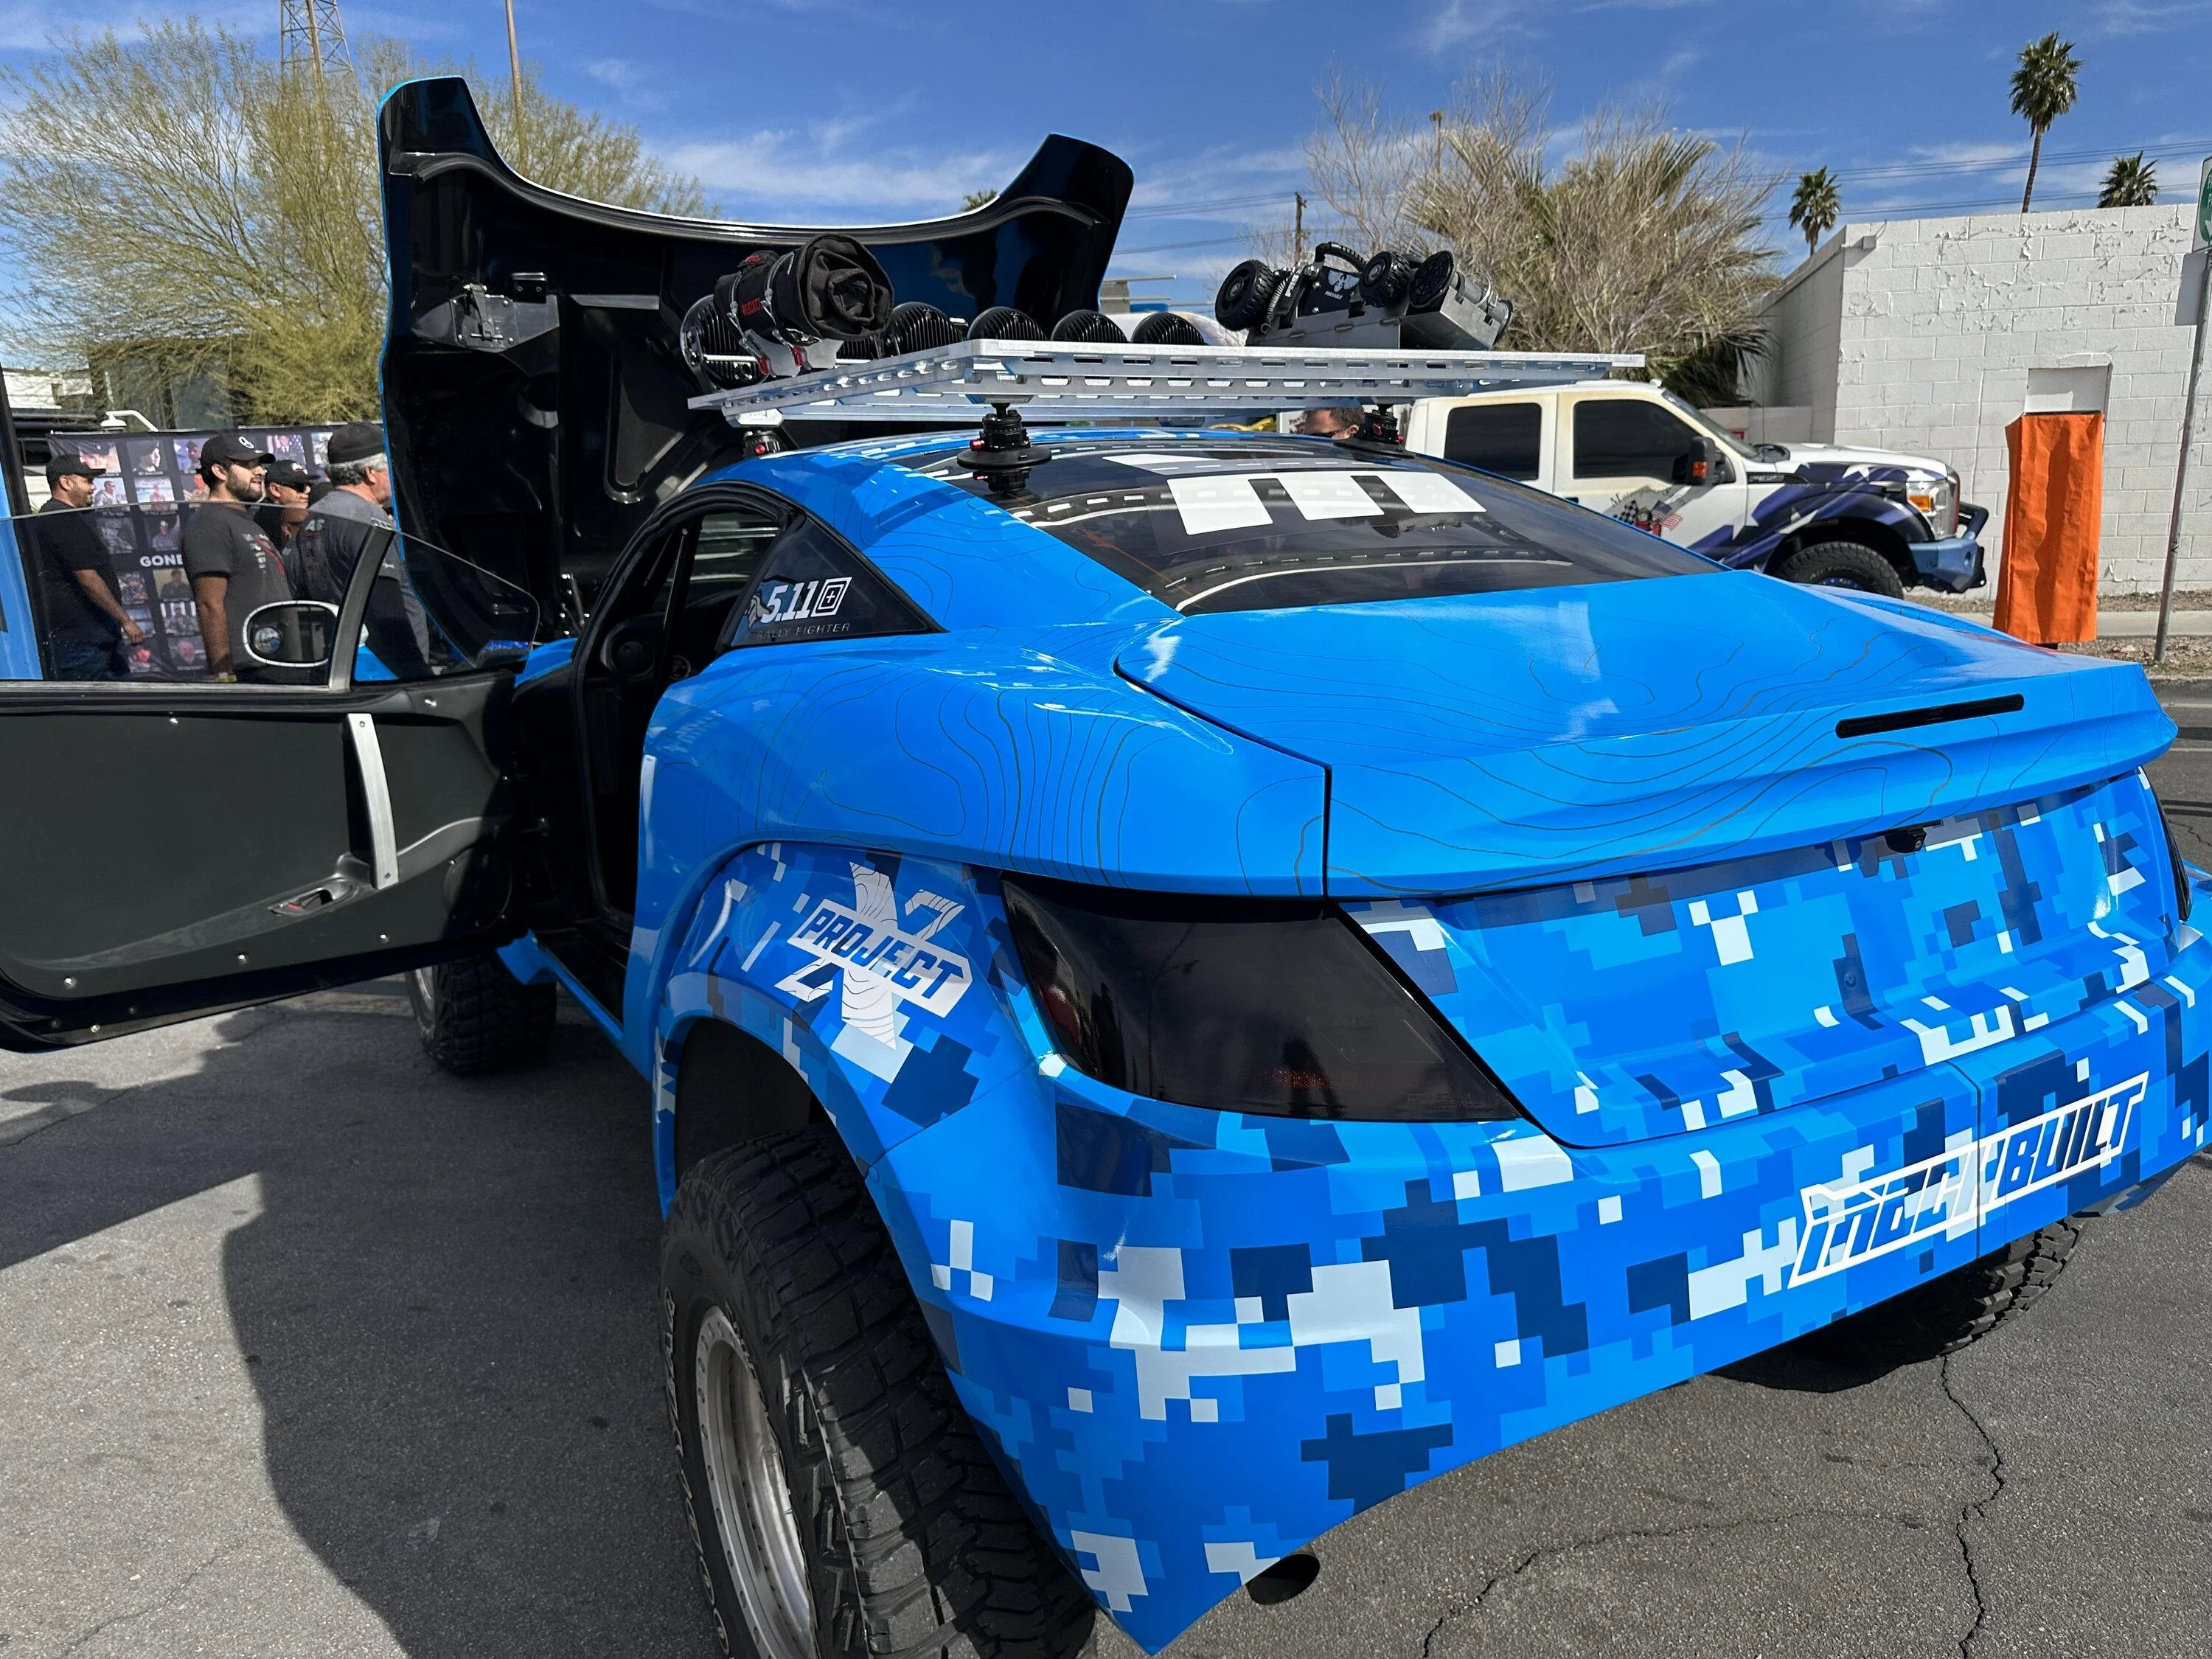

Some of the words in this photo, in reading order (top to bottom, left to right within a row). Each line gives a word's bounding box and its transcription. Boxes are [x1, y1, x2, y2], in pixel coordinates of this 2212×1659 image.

[760, 580, 819, 624] 5.11
[757, 627, 791, 640] RALLY
[795, 622, 850, 636] FIGHTER
[797, 907, 964, 999] PROJECT
